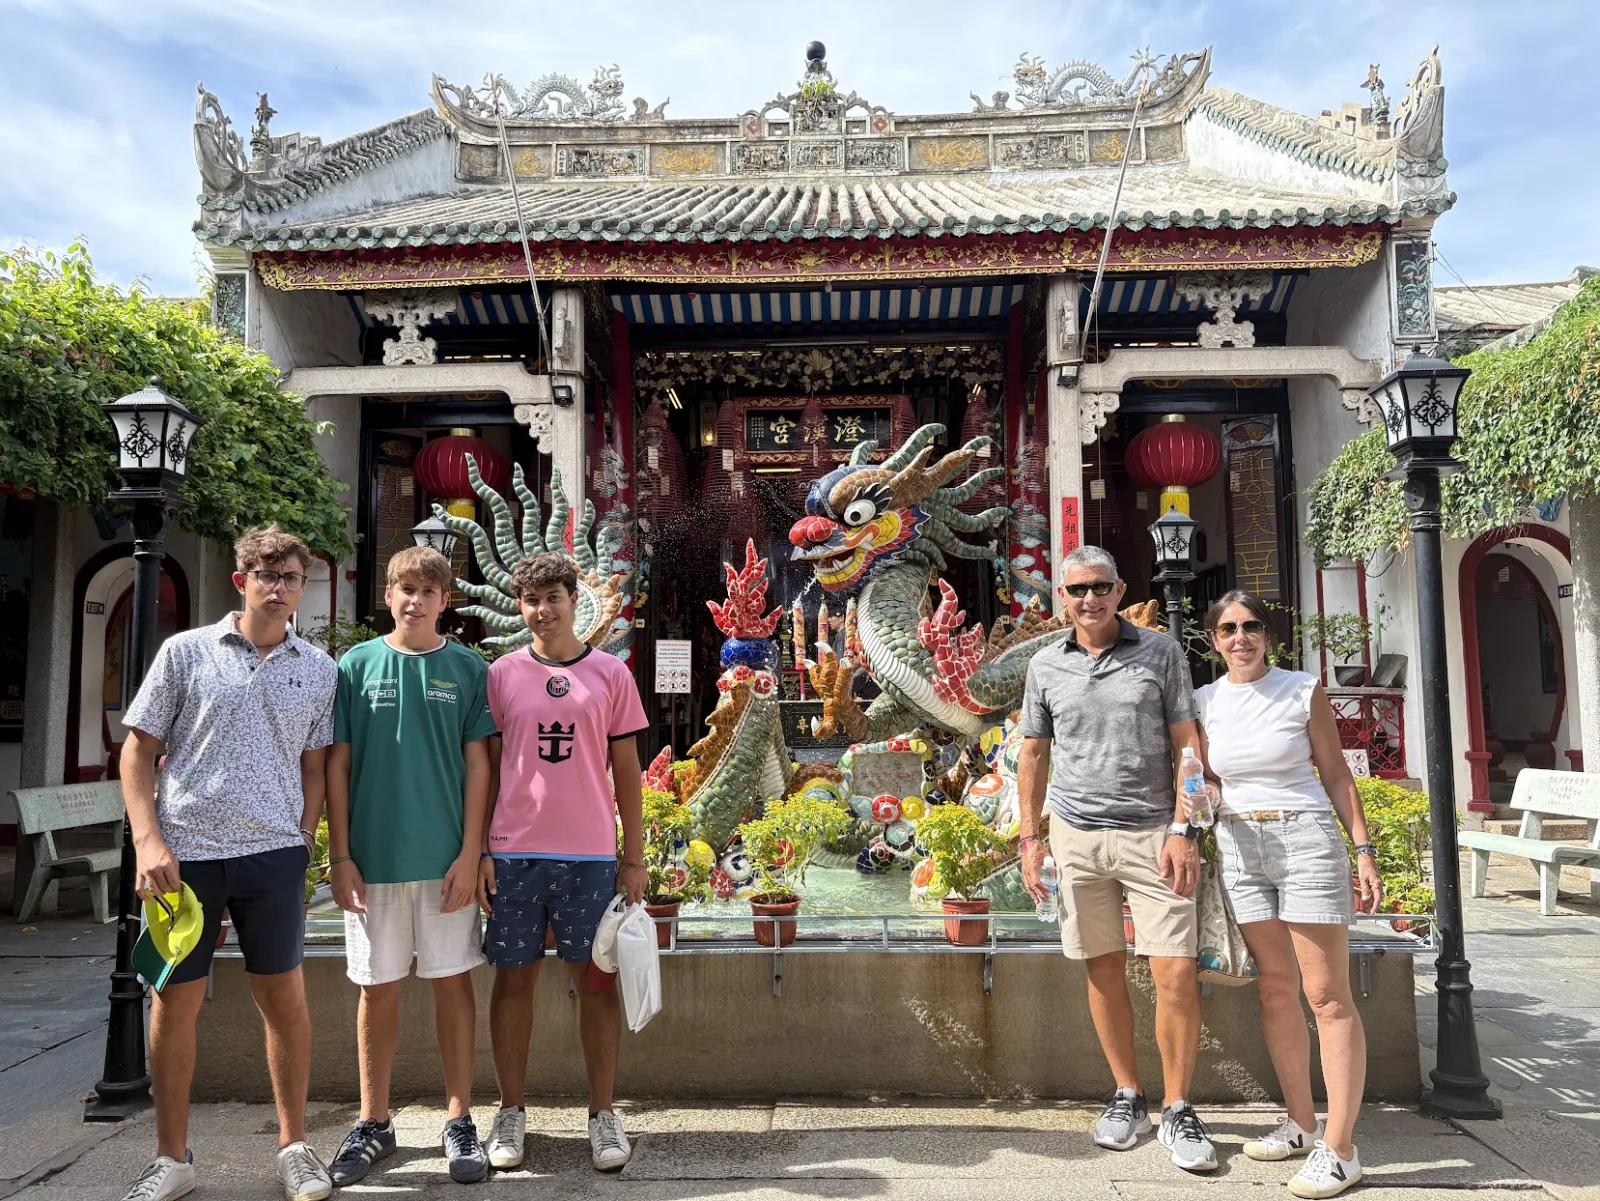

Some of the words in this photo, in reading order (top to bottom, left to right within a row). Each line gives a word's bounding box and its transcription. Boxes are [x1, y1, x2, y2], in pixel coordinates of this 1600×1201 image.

[366, 678, 398, 686] cognizant
[369, 690, 396, 699] JCB
[427, 690, 457, 700] aramco
